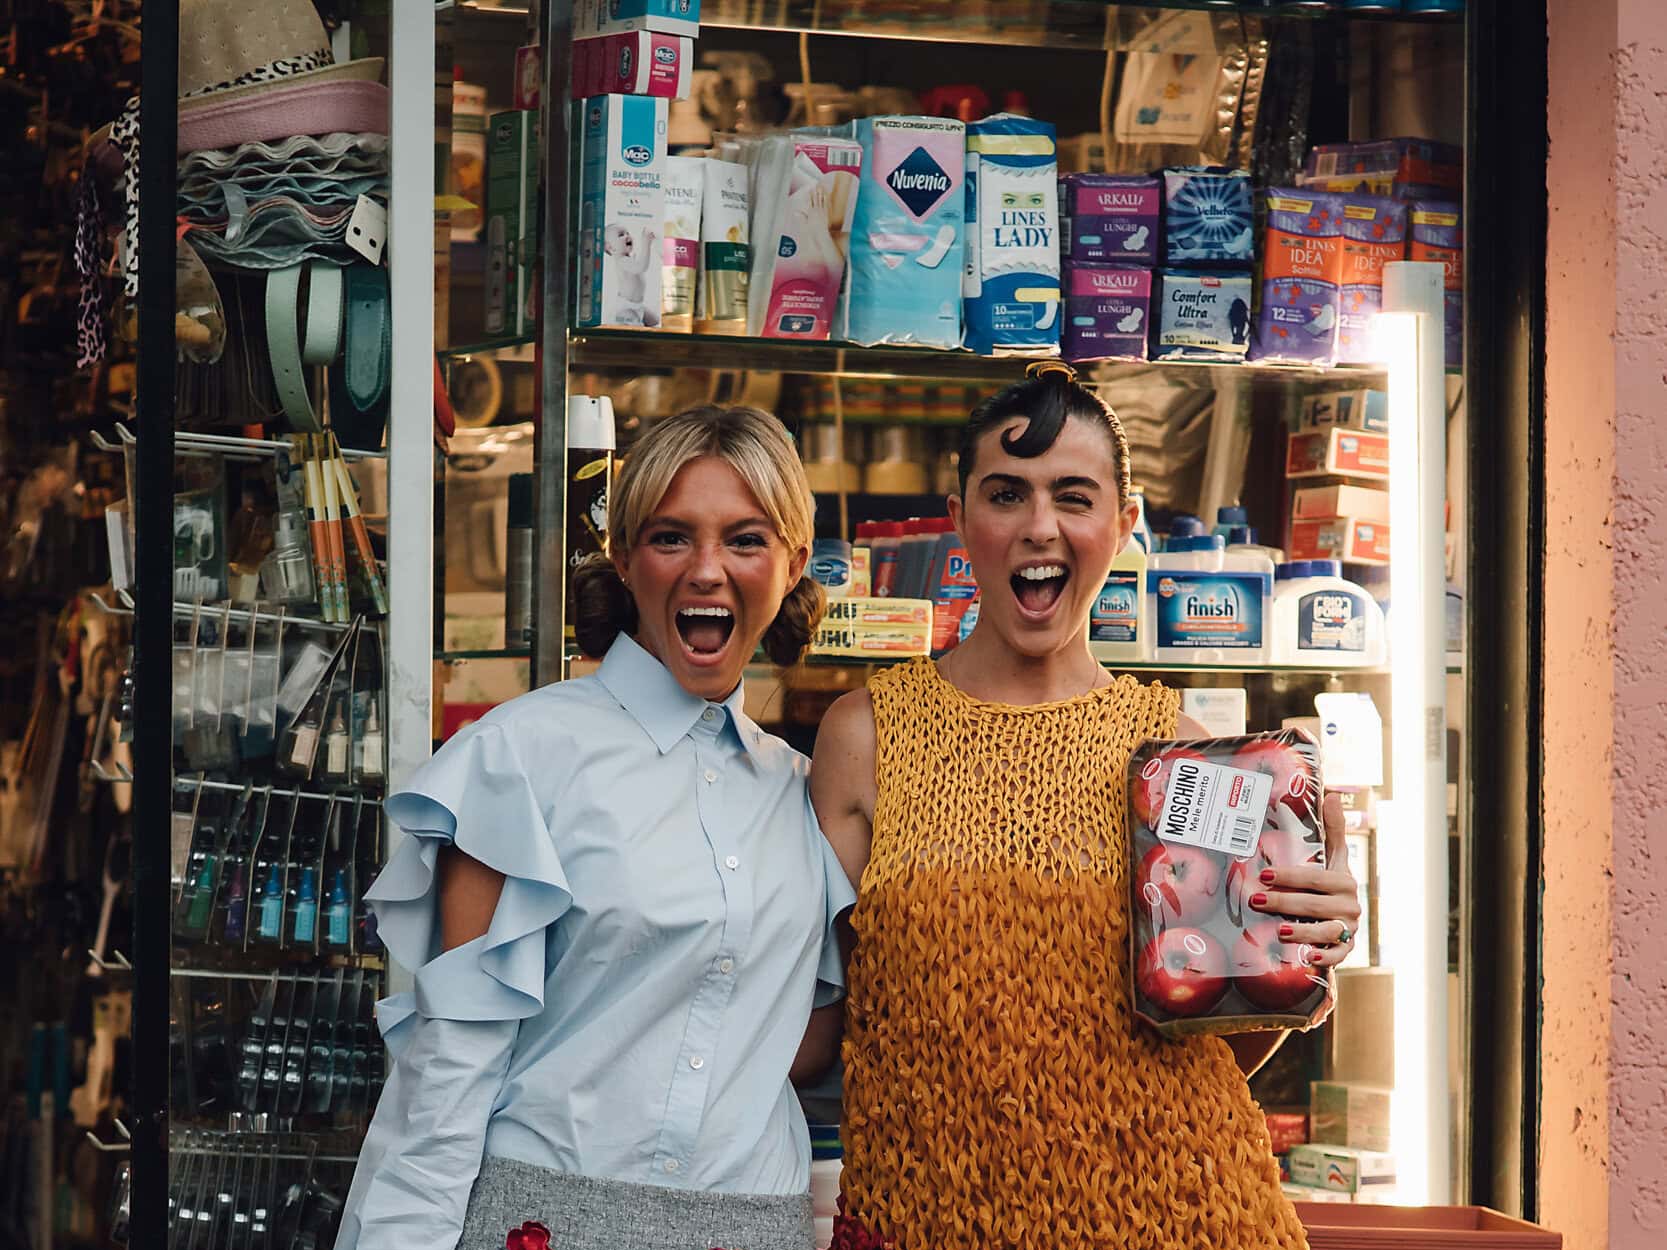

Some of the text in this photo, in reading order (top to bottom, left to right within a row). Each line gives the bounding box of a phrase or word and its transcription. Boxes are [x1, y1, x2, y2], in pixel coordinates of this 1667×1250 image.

[623, 149, 650, 161] Mac
[612, 170, 660, 181] BABY BOTTLE
[892, 168, 948, 192] Nuvenia
[1001, 211, 1046, 226] LINES
[1103, 223, 1138, 232] LUNGHI
[993, 227, 1053, 248] LADY
[1305, 240, 1336, 252] LINES
[1290, 248, 1324, 265] IDEA
[1171, 289, 1217, 306] Comfort
[994, 305, 1007, 315] 10
[1097, 304, 1132, 314] LUNGHI
[1177, 305, 1208, 318] Ultra
[1272, 307, 1286, 321] 12
[1100, 597, 1130, 611] finish
[1187, 596, 1234, 616] finish
[1165, 764, 1199, 836] MOSCHINO
[1189, 776, 1210, 832] Mele merito
